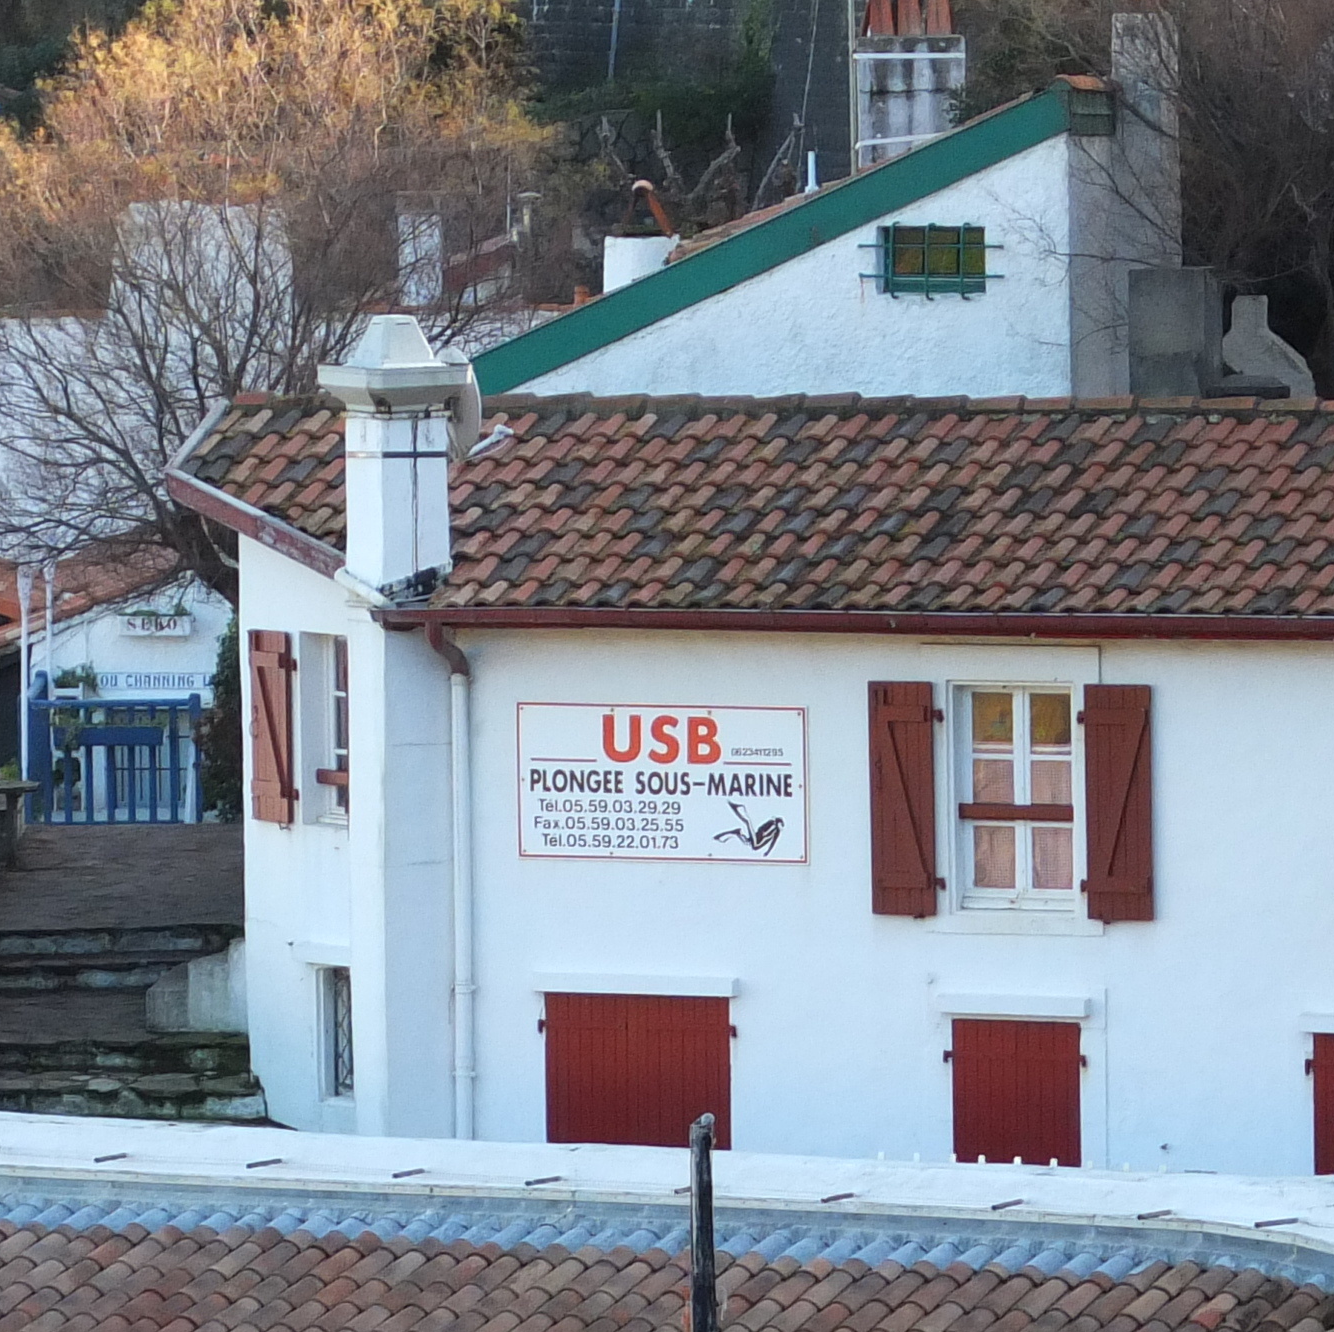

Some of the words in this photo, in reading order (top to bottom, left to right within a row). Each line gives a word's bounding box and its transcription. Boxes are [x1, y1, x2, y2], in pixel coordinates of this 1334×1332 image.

[601, 713, 722, 765] USB
[529, 769, 624, 794] PLONGEE
[636, 772, 793, 798] SOUS-MARINE
[534, 816, 684, 832] Fax.05.59.03.25.55
